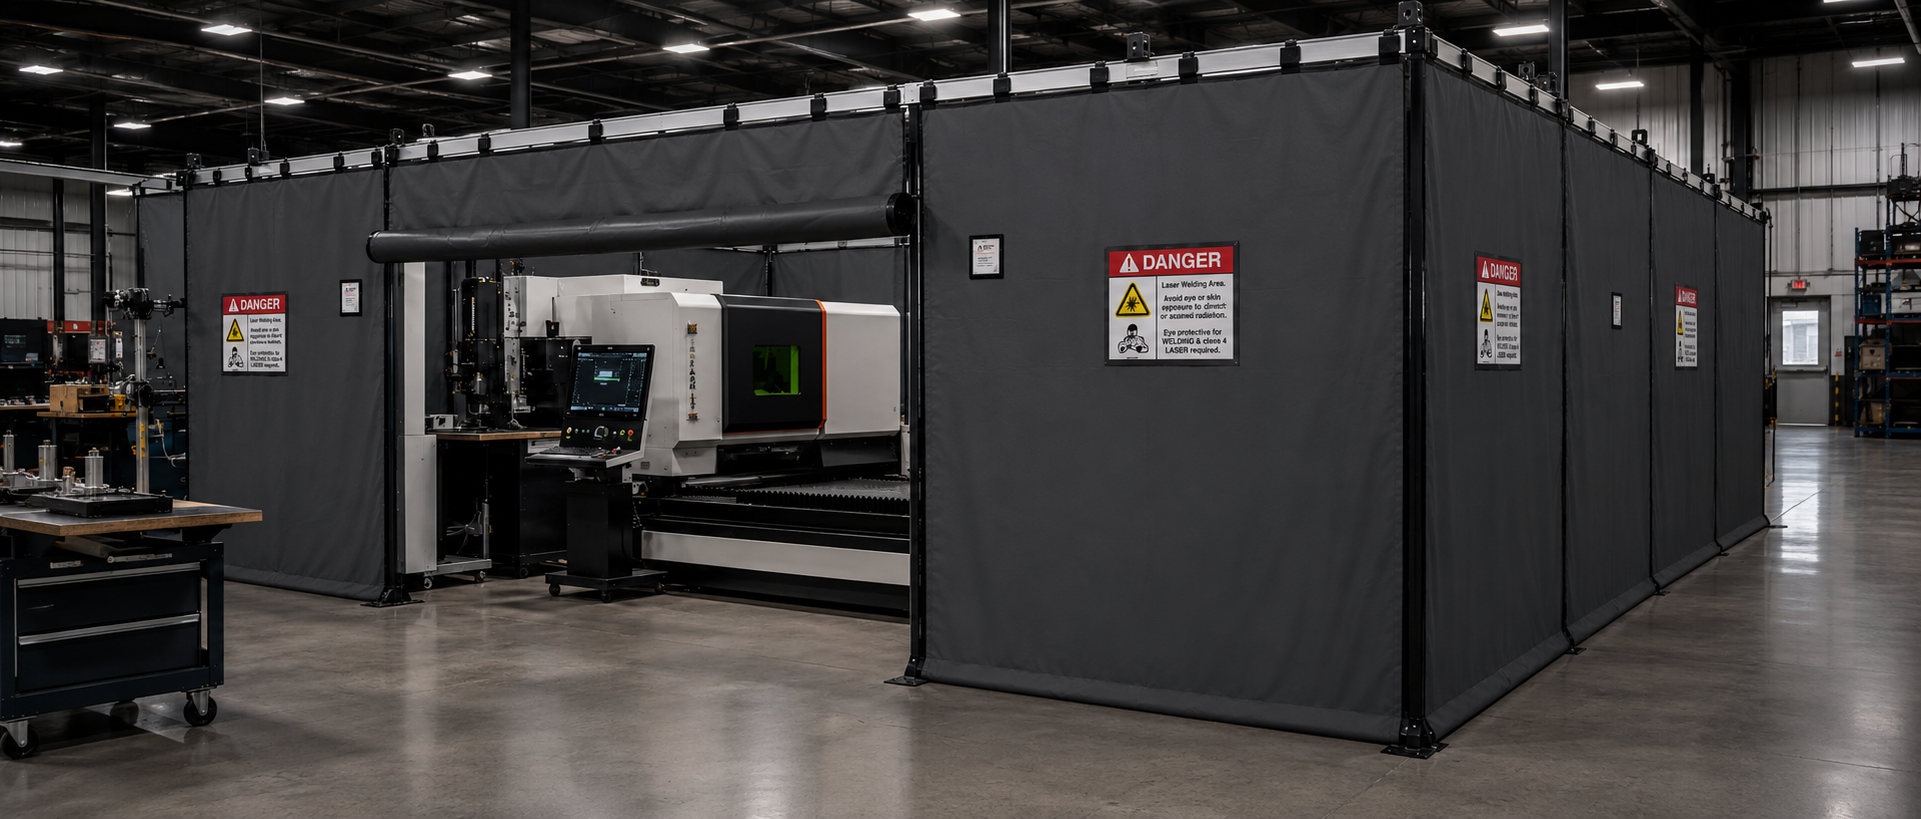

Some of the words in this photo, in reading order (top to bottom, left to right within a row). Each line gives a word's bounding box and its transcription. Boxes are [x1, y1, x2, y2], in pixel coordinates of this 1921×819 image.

[1143, 252, 1221, 270] DANGER
[1491, 263, 1517, 281] DANGER
[241, 298, 280, 310] DANGER
[1190, 346, 1221, 355] required.
